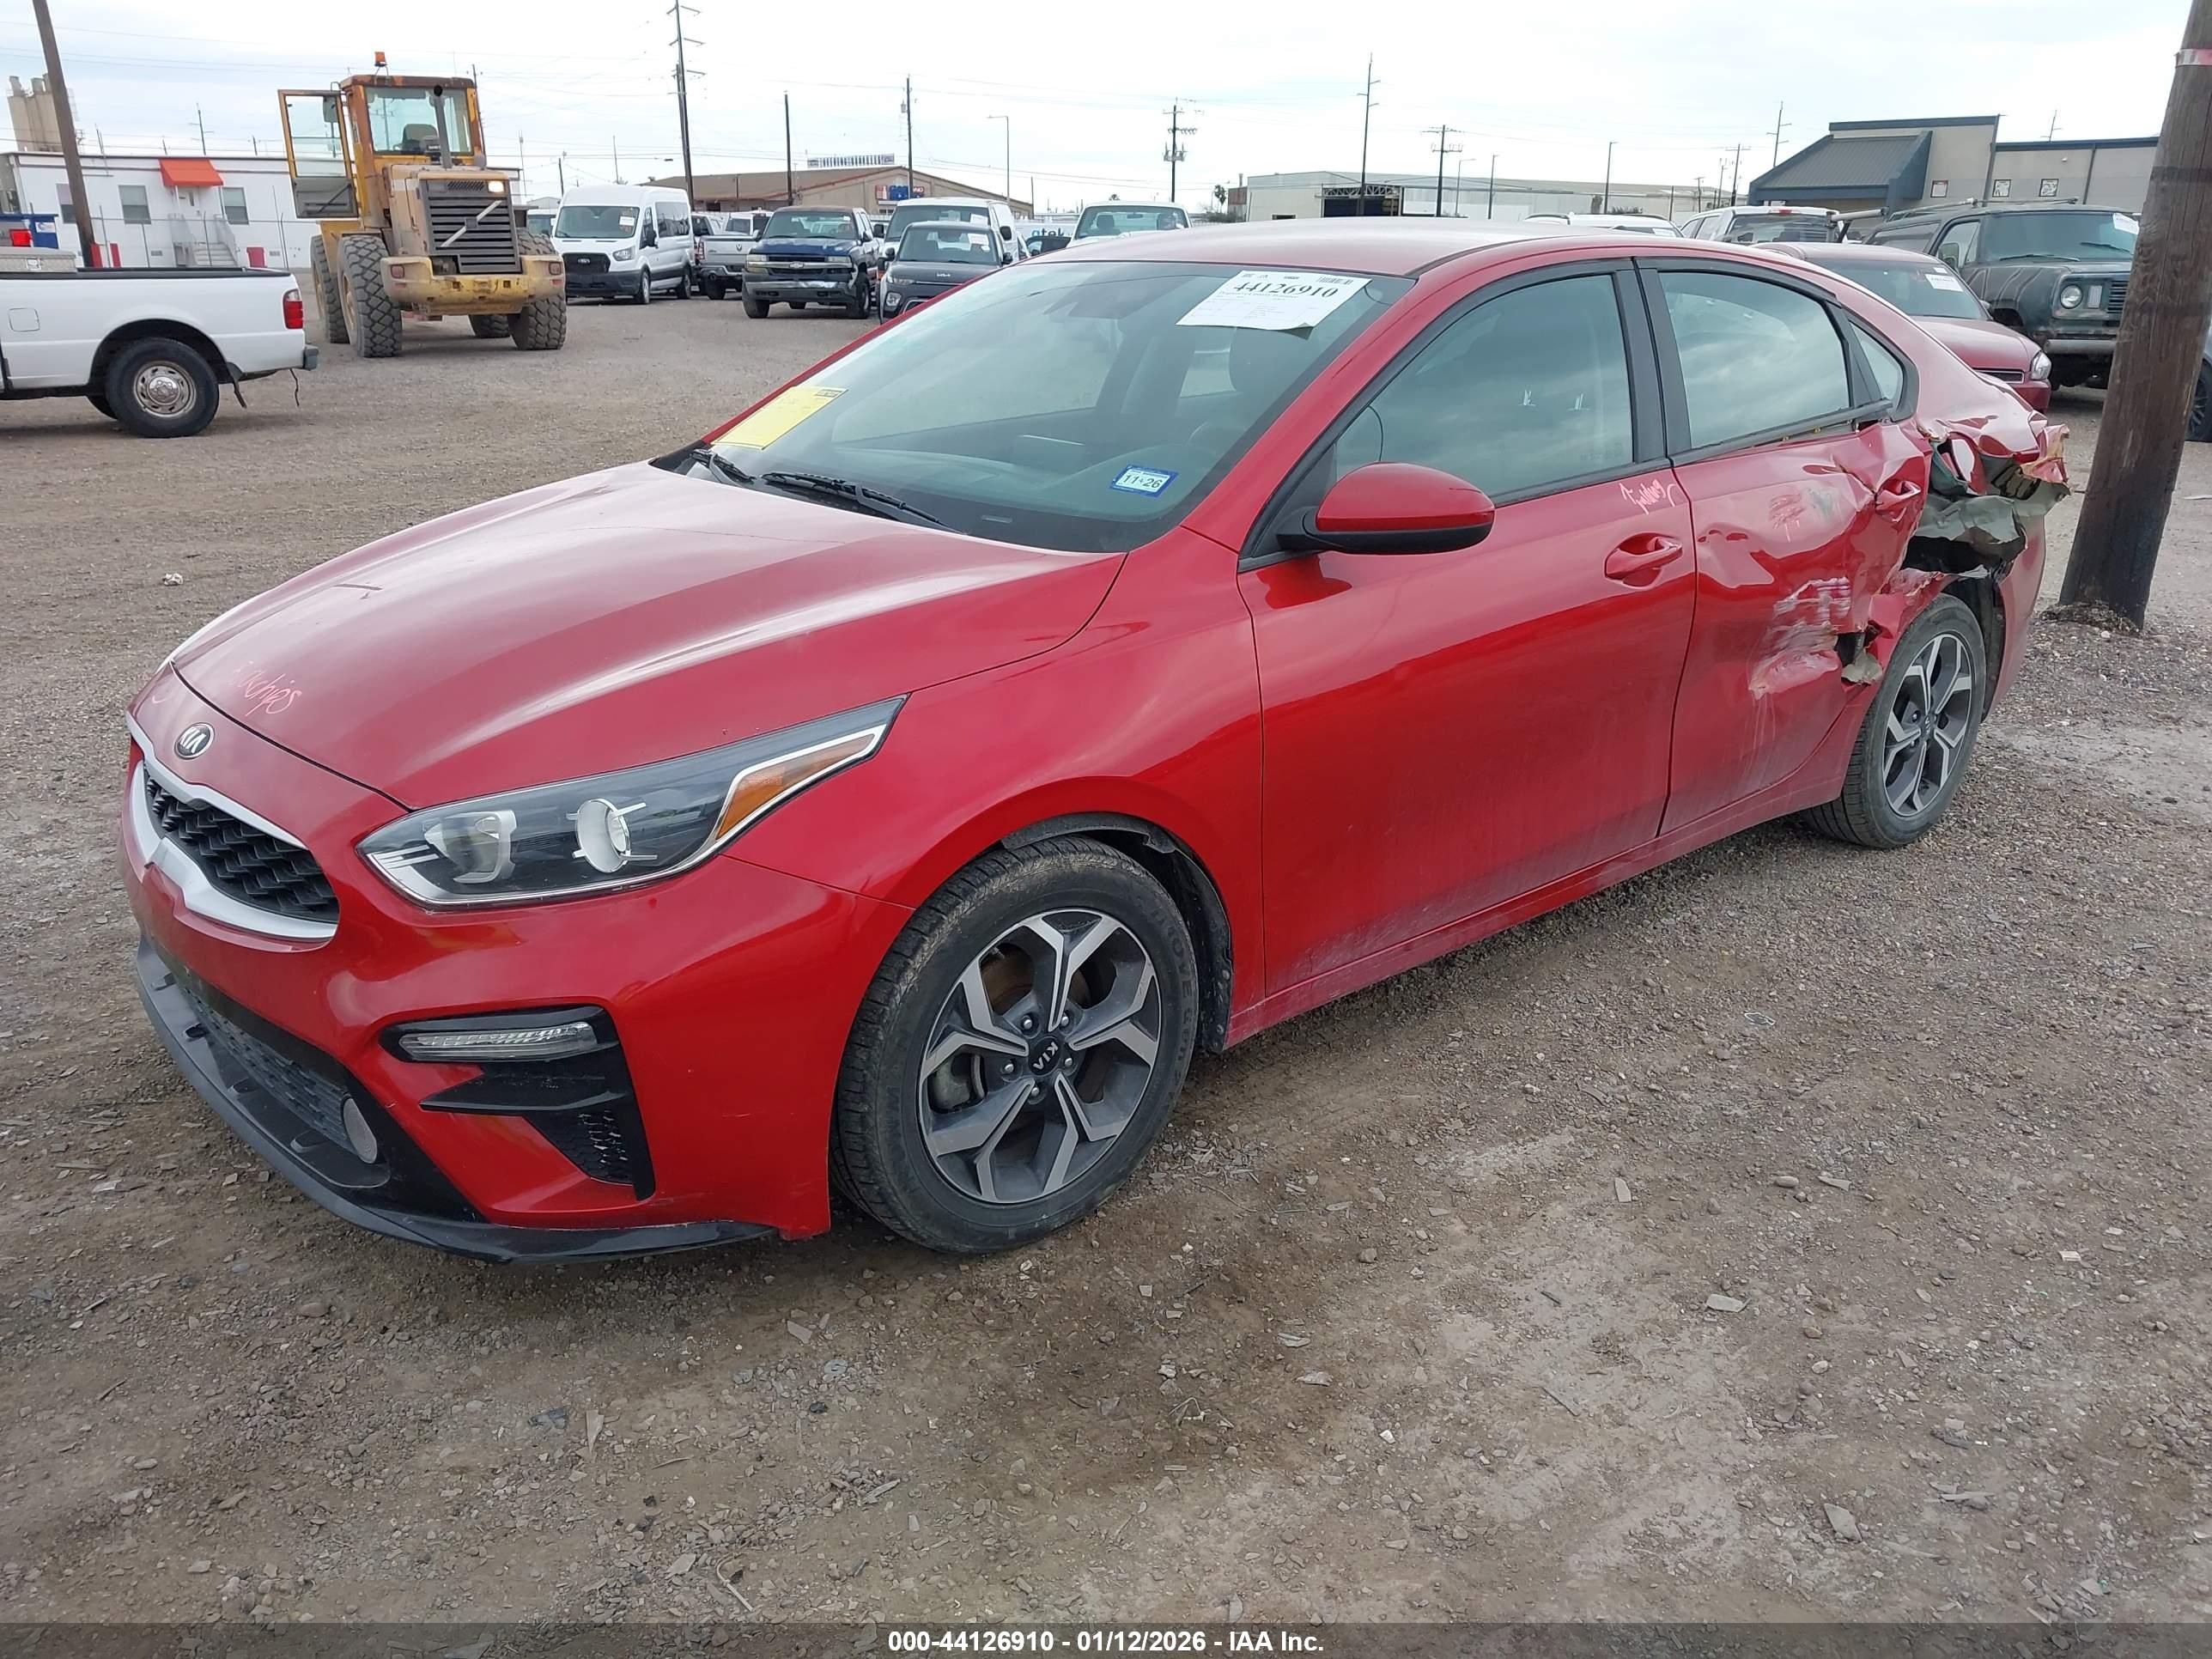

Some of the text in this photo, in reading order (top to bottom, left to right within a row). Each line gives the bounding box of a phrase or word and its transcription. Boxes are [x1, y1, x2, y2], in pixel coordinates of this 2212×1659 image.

[1233, 281, 1339, 298] 44126910
[179, 726, 207, 754] KIA
[1032, 1041, 1059, 1070] KIA
